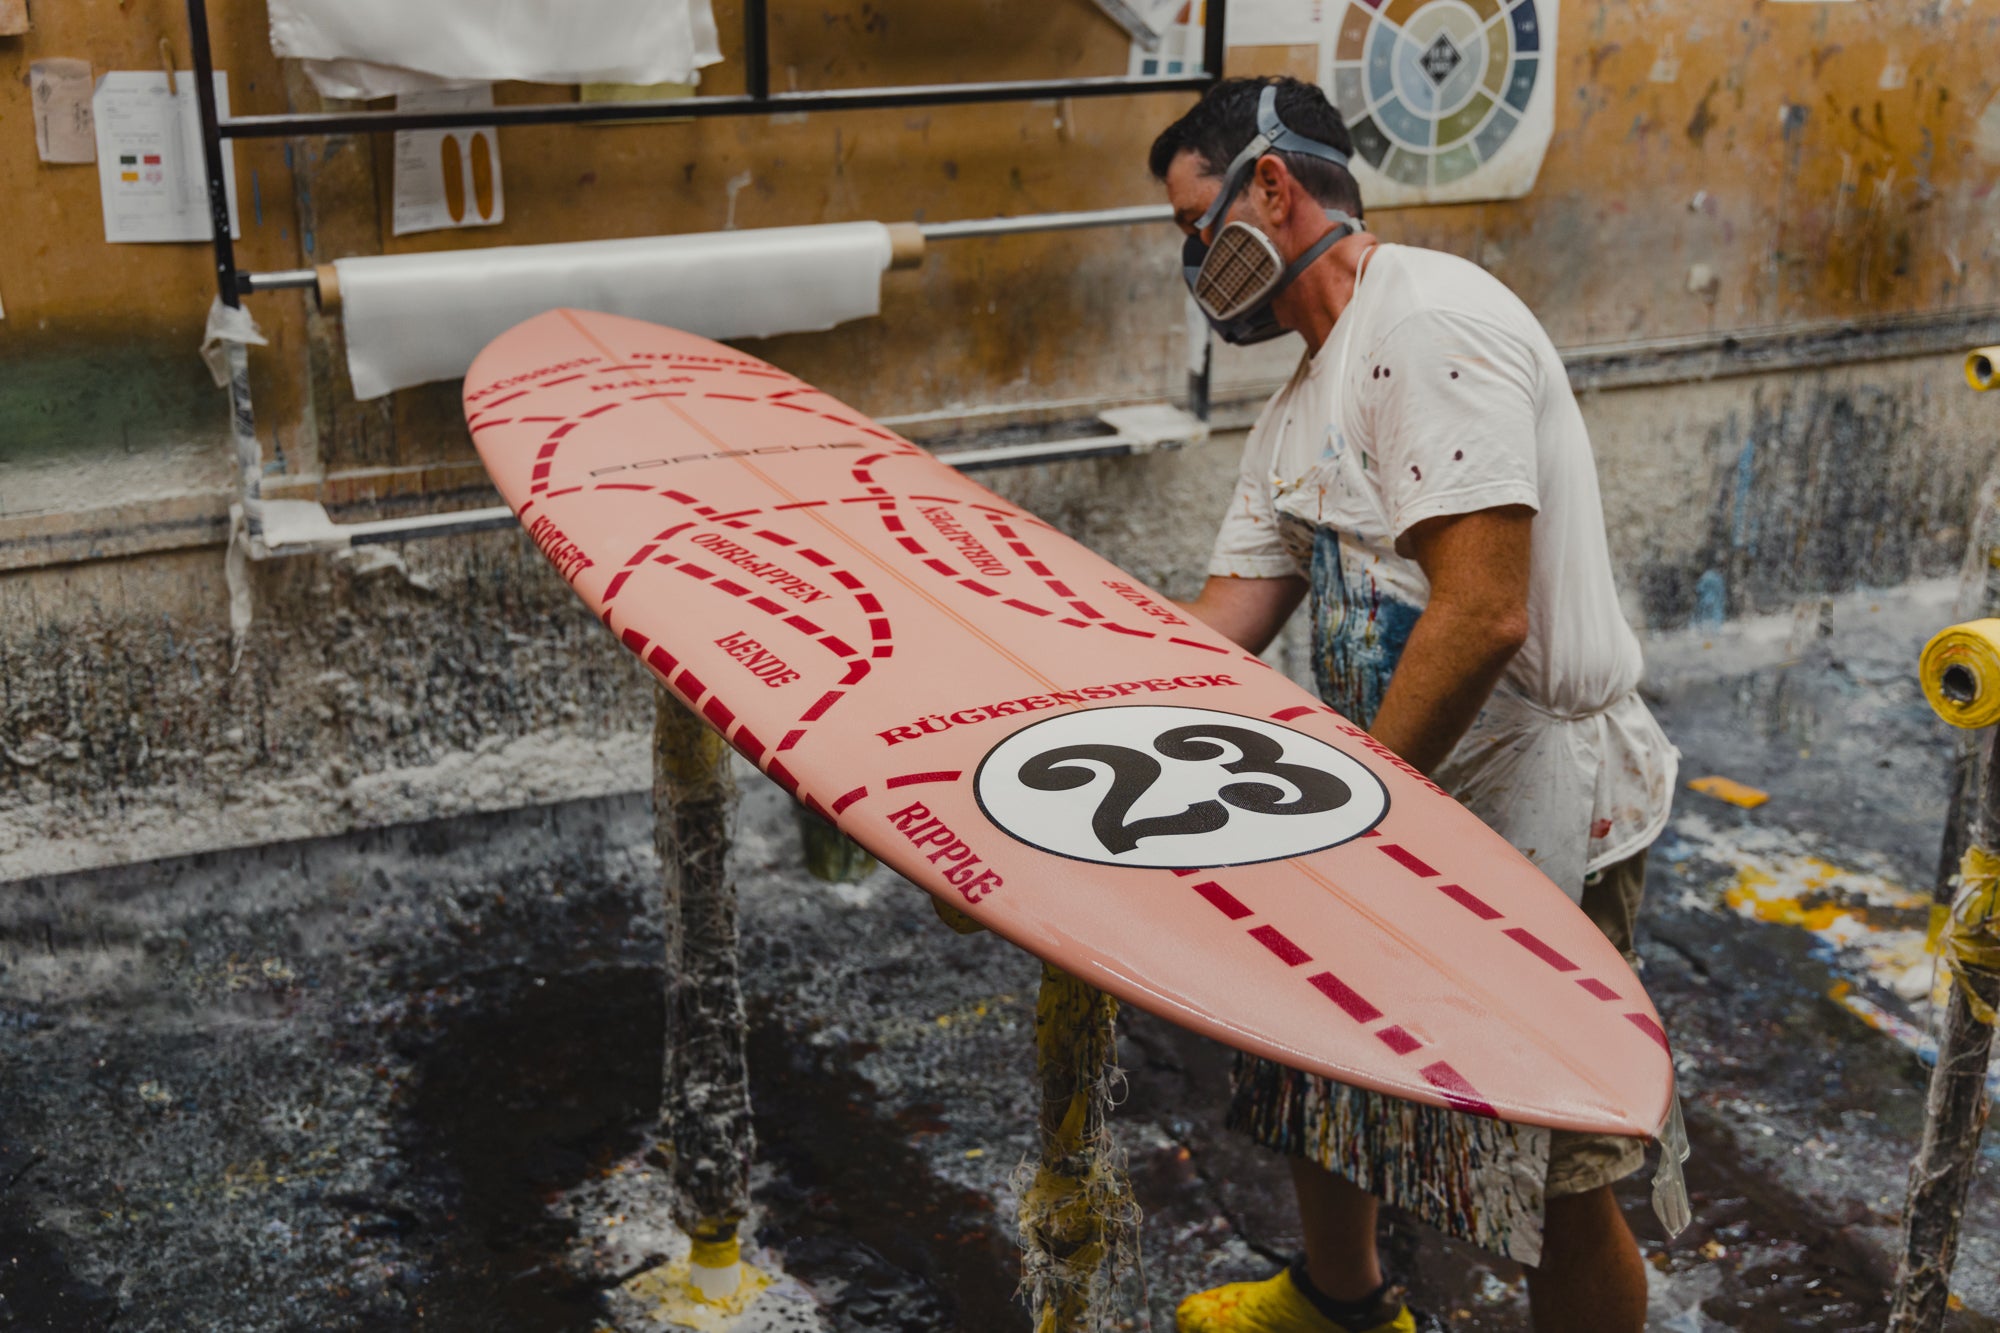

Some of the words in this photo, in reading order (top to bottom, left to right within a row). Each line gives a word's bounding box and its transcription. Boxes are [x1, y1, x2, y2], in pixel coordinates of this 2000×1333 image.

[588, 442, 866, 478] PORSCHE
[689, 532, 833, 605] OHRLAPPEN
[916, 506, 1012, 577] OHRLAPPEN
[1101, 580, 1191, 627] LENDE
[713, 630, 802, 689] LENDE
[875, 674, 1242, 747] RÜCKENSPECK
[1017, 723, 1353, 856] 23
[886, 800, 1005, 905] RIPPLE
